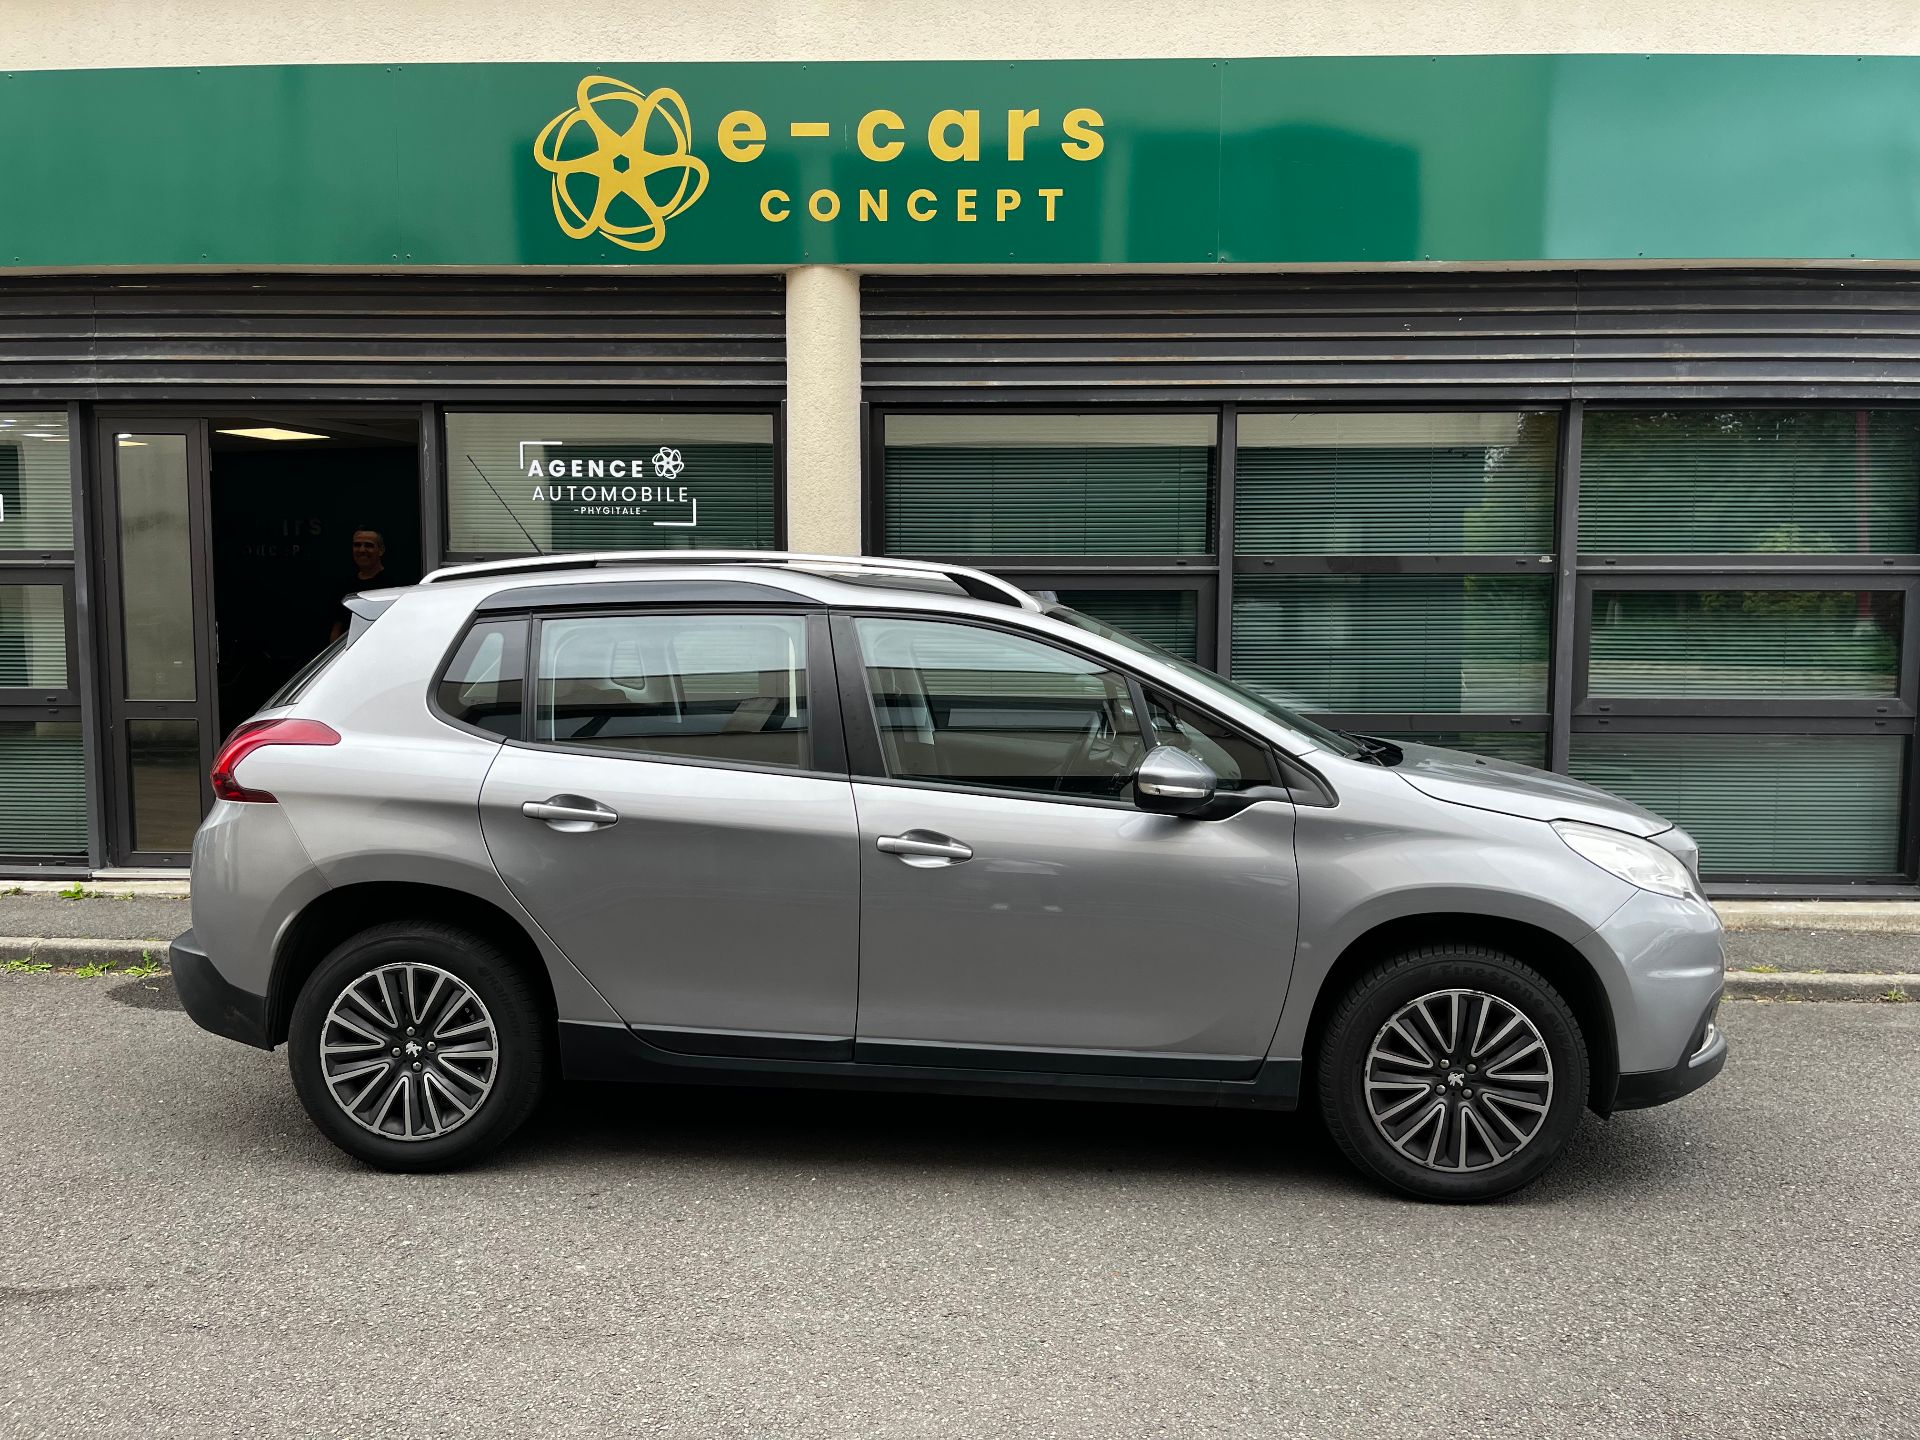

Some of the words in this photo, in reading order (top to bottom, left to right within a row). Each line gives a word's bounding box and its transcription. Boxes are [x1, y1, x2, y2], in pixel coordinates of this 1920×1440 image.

[760, 188, 1064, 222] CONCEPT
[527, 459, 643, 478] AGENCE
[532, 485, 688, 502] AUTOMOBILE
